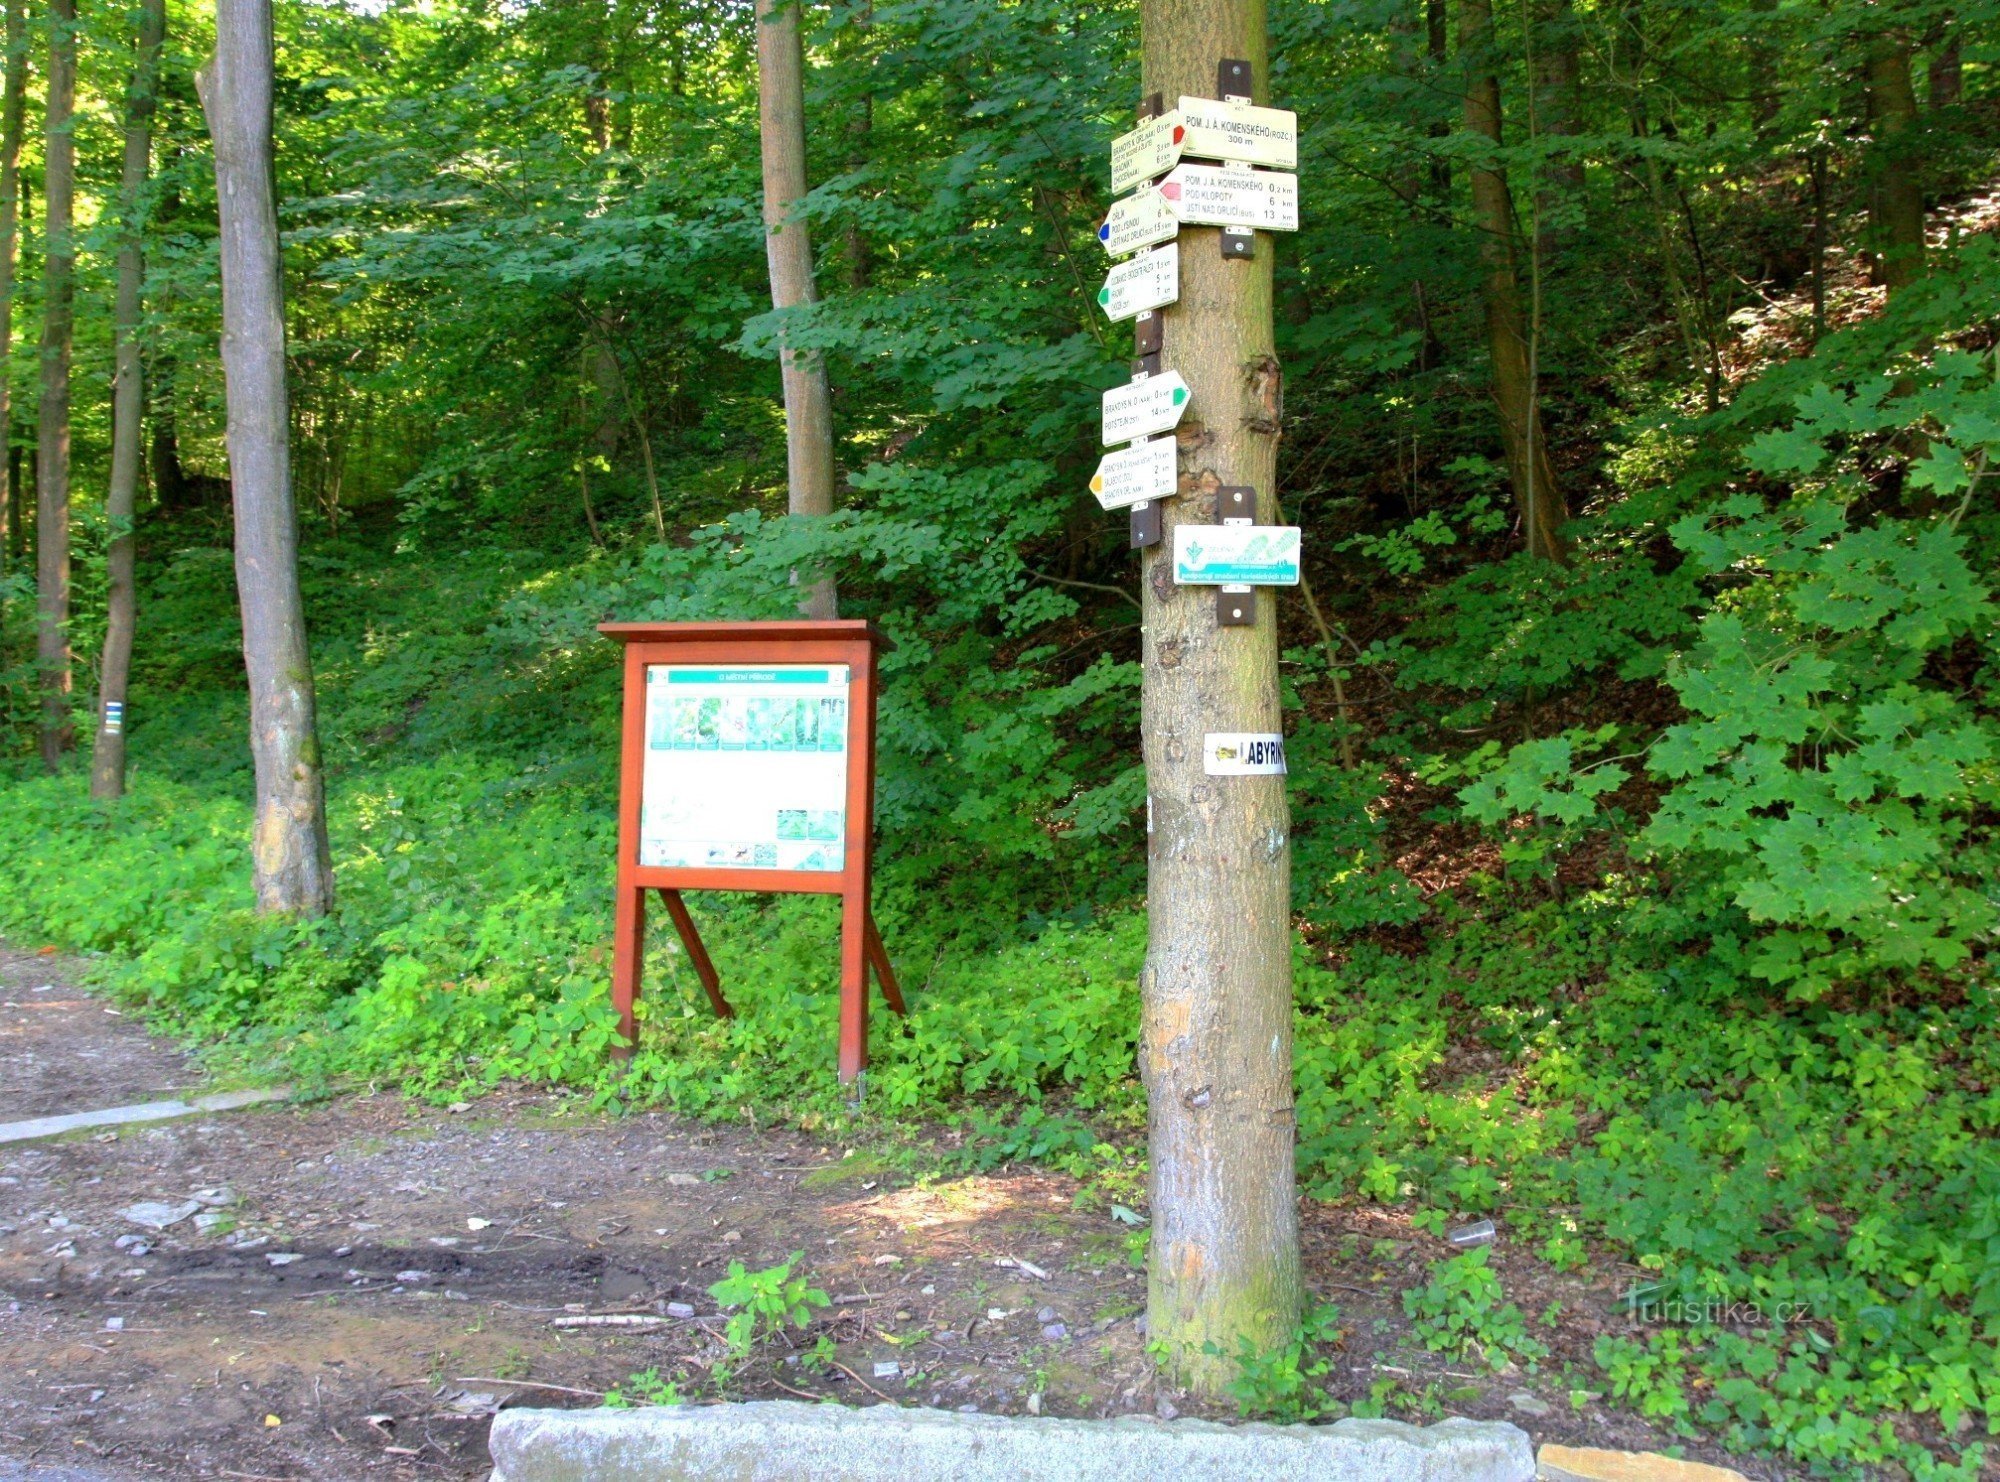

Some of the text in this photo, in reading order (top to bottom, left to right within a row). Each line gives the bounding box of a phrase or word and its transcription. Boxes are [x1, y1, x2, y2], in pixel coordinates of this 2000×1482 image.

[1186, 115, 1203, 128] POM.
[1205, 118, 1211, 129] J.
[1221, 120, 1269, 138] KOMENSKÉHO
[1228, 135, 1243, 145] 300
[1218, 178, 1263, 192] KOMENSKÉHO
[1269, 183, 1281, 194] 0,2
[1185, 189, 1200, 199] POD
[1201, 191, 1233, 202] KLOPOTY
[1269, 197, 1275, 206] 6
[1157, 209, 1162, 218] 6
[1202, 204, 1215, 214] NAD
[1264, 210, 1275, 219] 13
